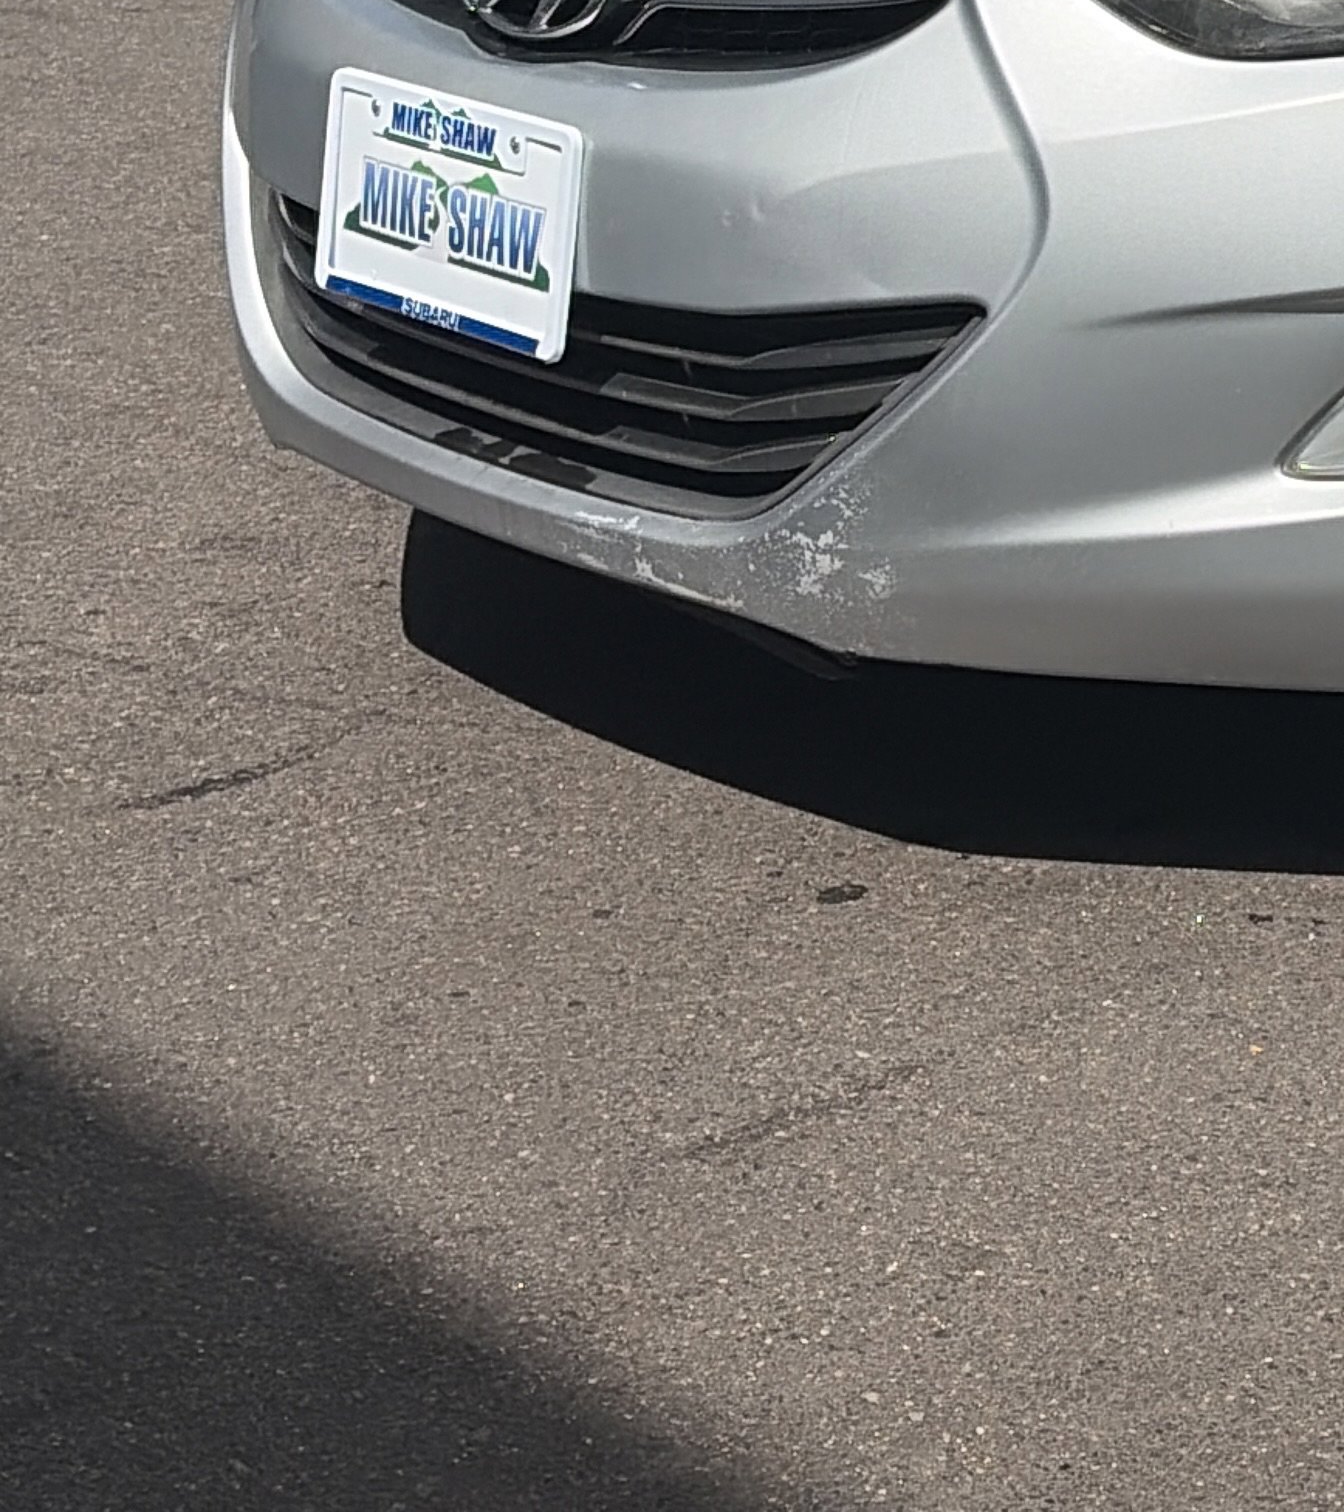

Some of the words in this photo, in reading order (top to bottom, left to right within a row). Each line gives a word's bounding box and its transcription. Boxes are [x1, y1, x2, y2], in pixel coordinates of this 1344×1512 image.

[391, 101, 433, 139] MIKE
[440, 115, 497, 156] SHAW
[363, 161, 435, 241] MIKE
[449, 188, 545, 275] SHAW
[403, 296, 461, 330] SUBARU
